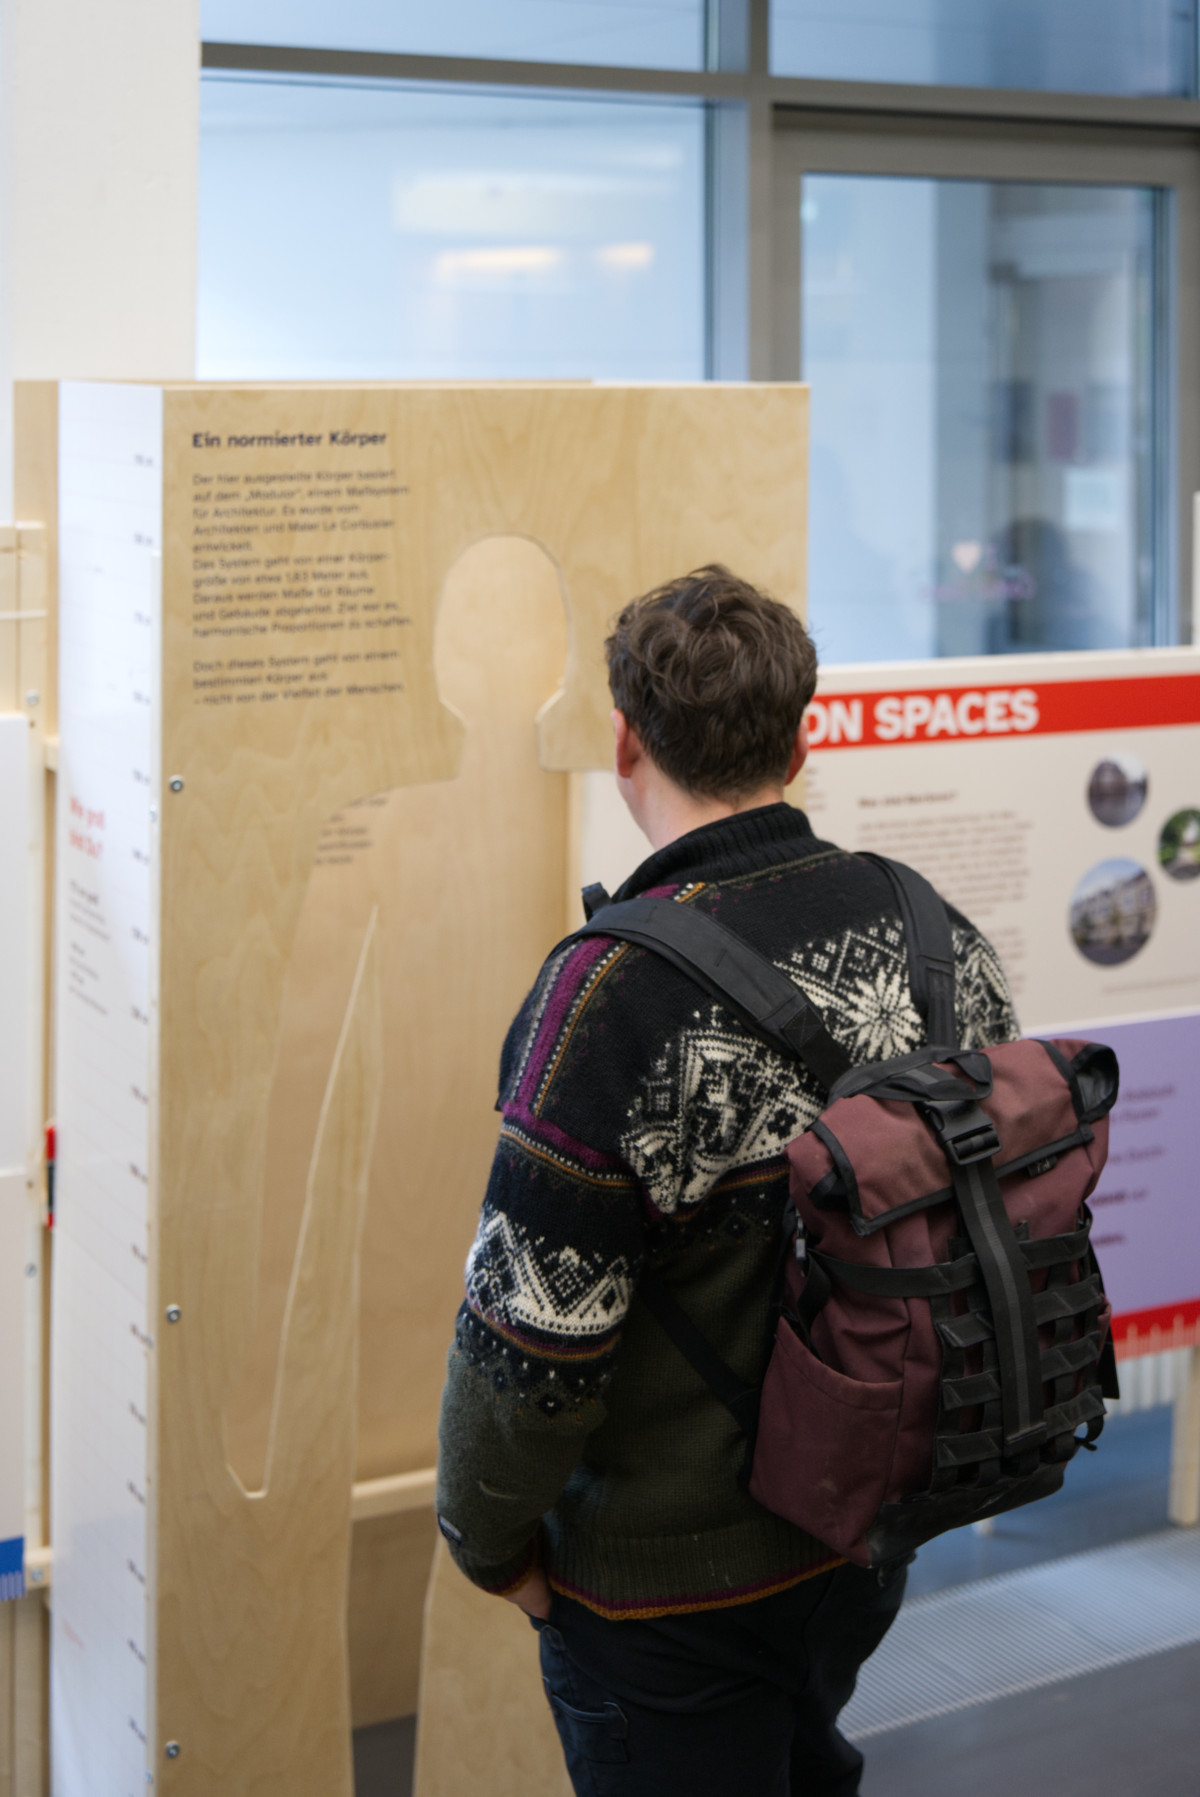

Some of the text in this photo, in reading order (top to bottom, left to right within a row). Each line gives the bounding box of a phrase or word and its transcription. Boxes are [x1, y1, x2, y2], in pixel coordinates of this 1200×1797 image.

[192, 430, 388, 448] Ein normierter Körper
[193, 473, 213, 485] Der
[193, 490, 212, 502] auf
[215, 490, 240, 501] dem
[874, 688, 1040, 740] SPACES
